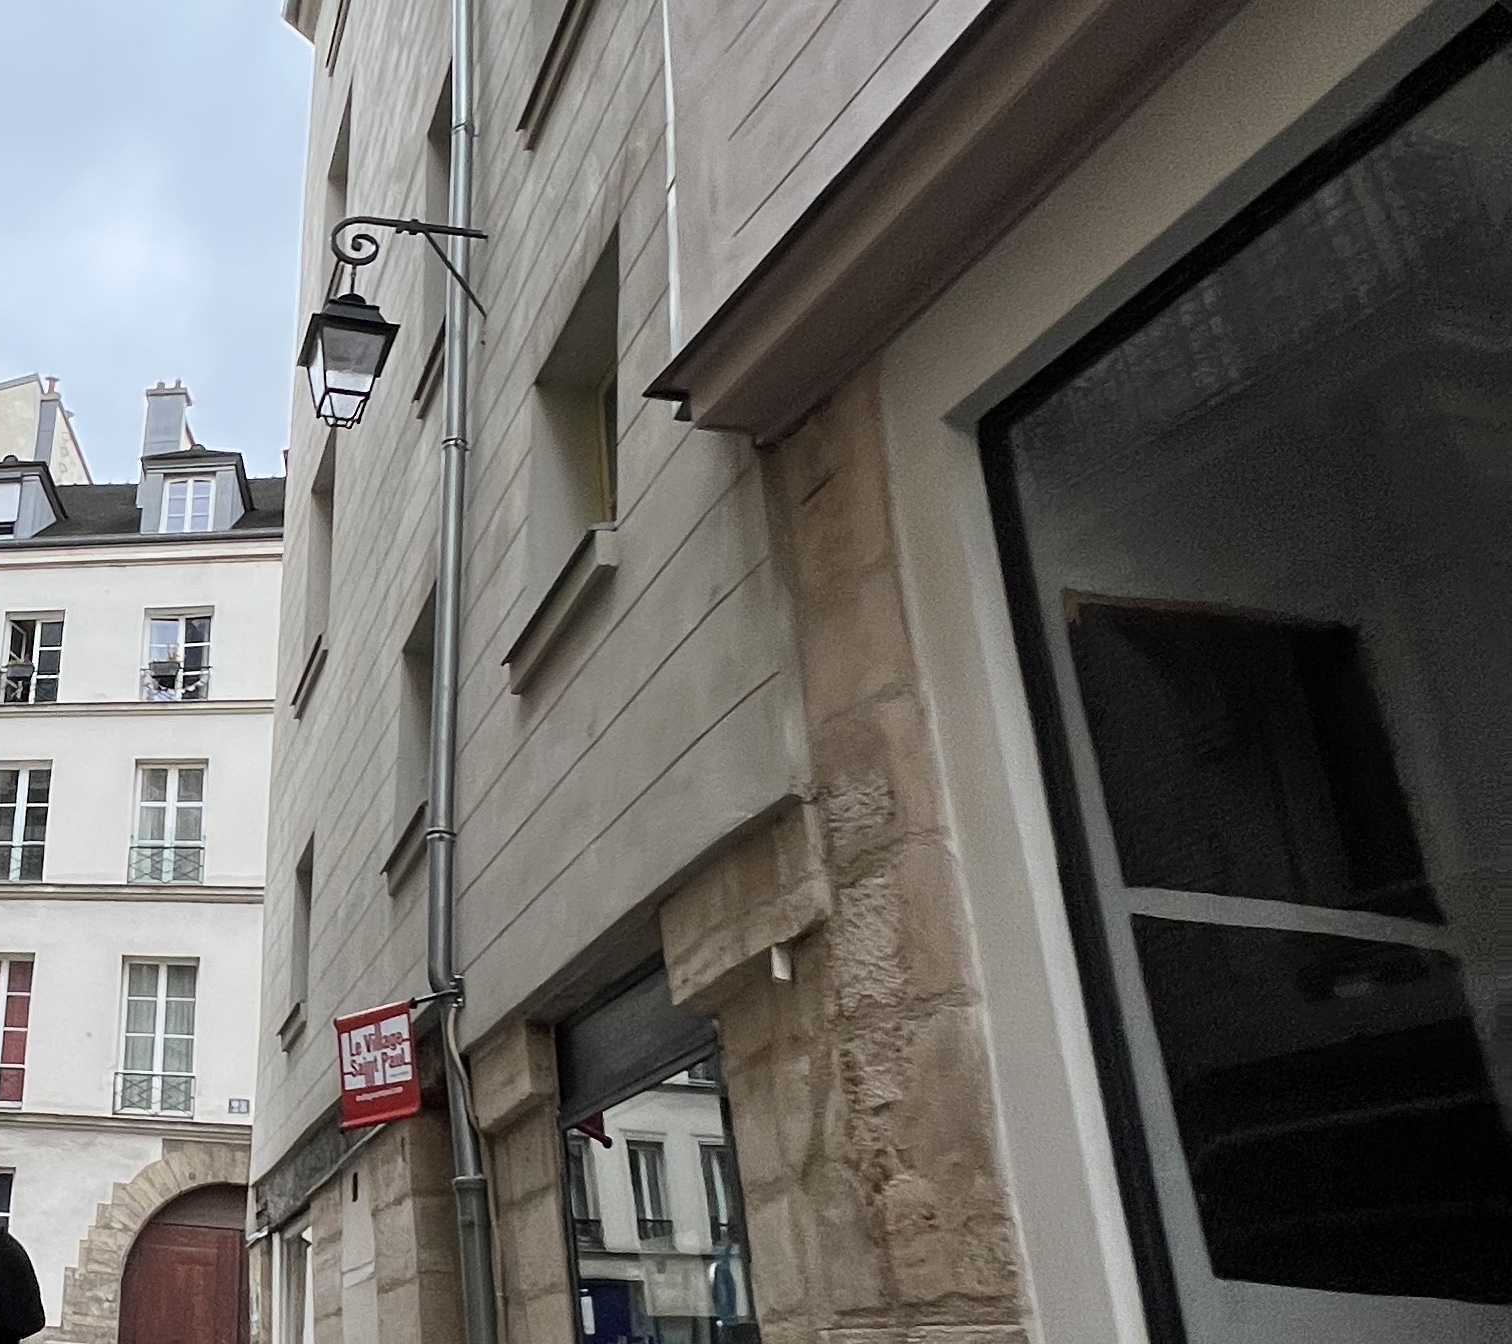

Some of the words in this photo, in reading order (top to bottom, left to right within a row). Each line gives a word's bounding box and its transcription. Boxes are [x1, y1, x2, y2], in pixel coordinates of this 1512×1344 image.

[362, 1029, 403, 1053] Village
[350, 1055, 379, 1077] Saint
[381, 1047, 407, 1076] Paul
